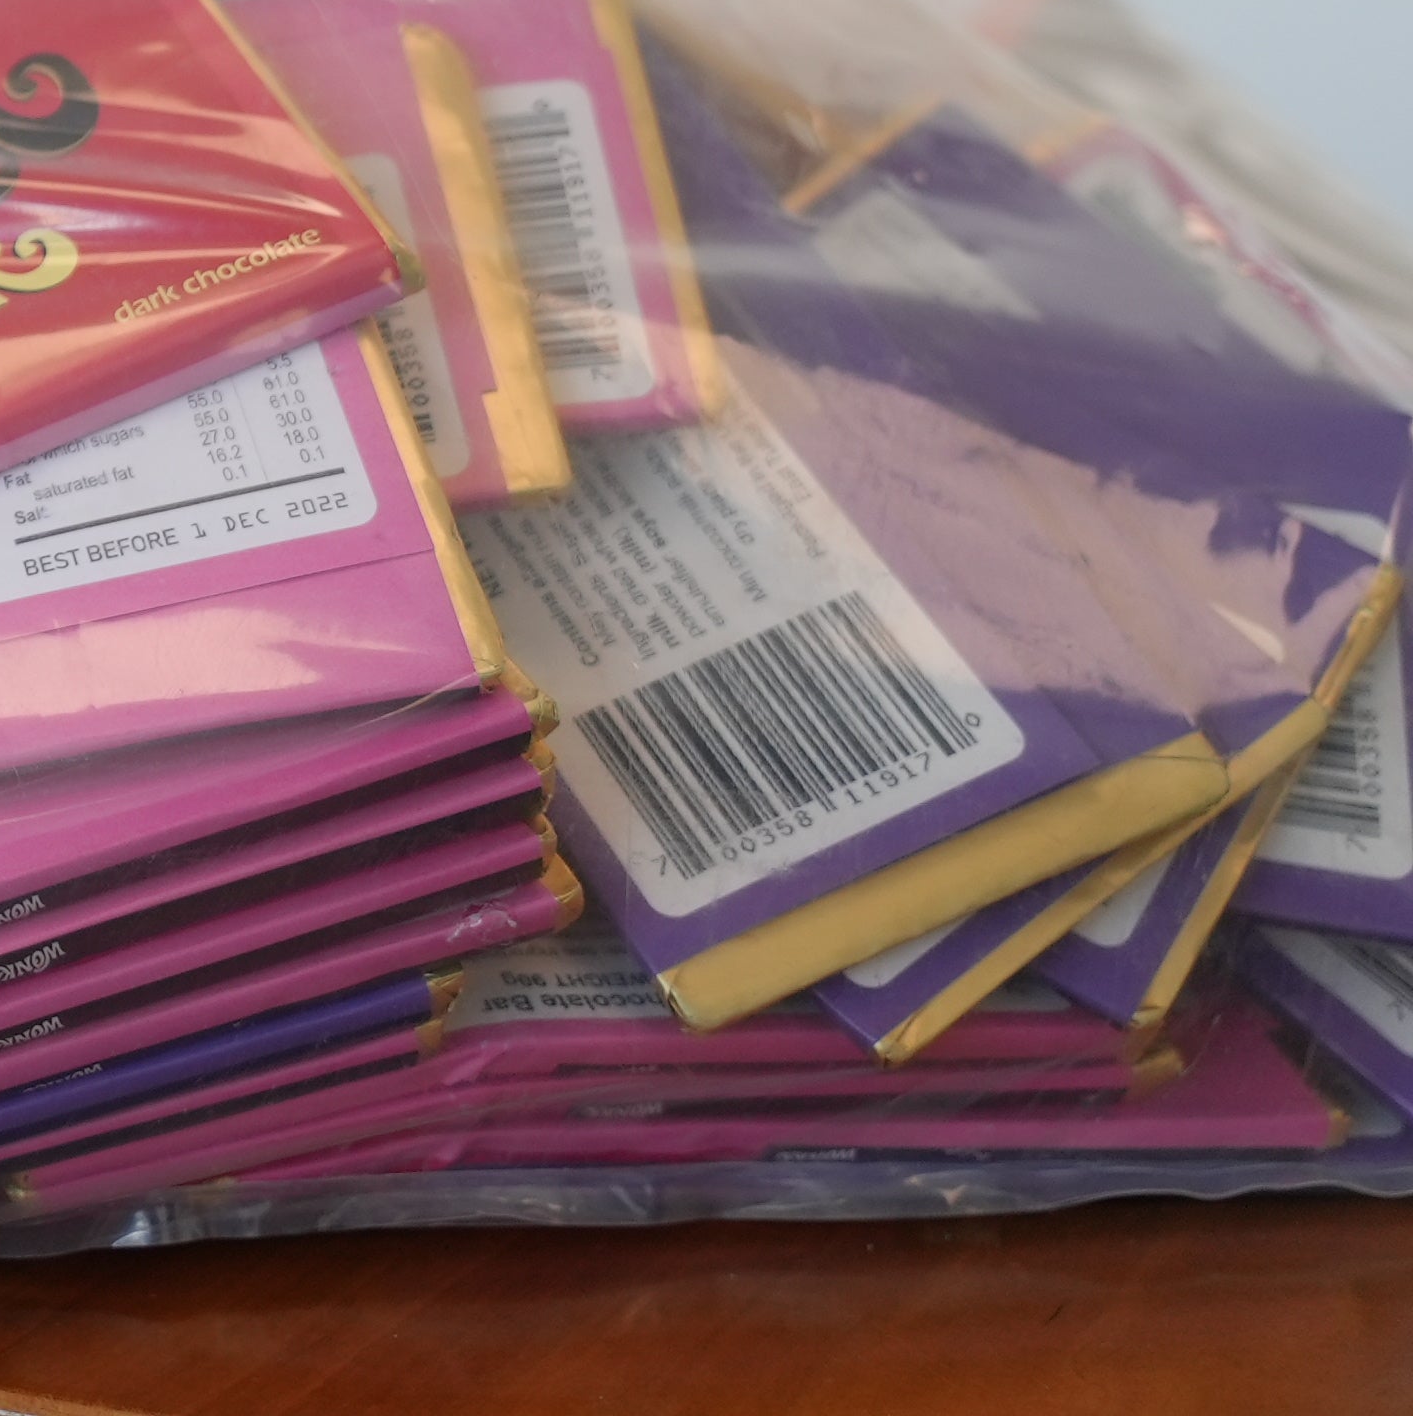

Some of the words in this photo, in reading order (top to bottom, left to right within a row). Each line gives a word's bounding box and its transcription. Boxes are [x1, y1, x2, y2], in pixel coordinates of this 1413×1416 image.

[114, 285, 181, 323] dark
[183, 229, 321, 293] chocolate
[90, 425, 145, 448] sugars
[193, 408, 229, 428] 55.0
[269, 389, 305, 409] 61.0
[187, 389, 223, 409] 55.0
[3, 471, 32, 490] Fat
[200, 426, 235, 446] 27.0
[275, 407, 312, 428] 30.0
[33, 470, 107, 501] saturated
[111, 465, 135, 482] fat
[207, 444, 243, 464] 16.2
[283, 426, 319, 446] 18.0
[223, 464, 247, 482] 0.1
[299, 445, 325, 464] 0.1
[23, 549, 80, 577] BEST
[86, 527, 179, 564] BEFORE
[191, 522, 207, 539] 1
[222, 508, 270, 532] DEC
[286, 491, 349, 519] 2022
[722, 810, 814, 862] 00358
[843, 751, 934, 807] 11917
[965, 711, 981, 728] 0
[483, 994, 535, 1012] Bar
[540, 992, 667, 1011] hocolate
